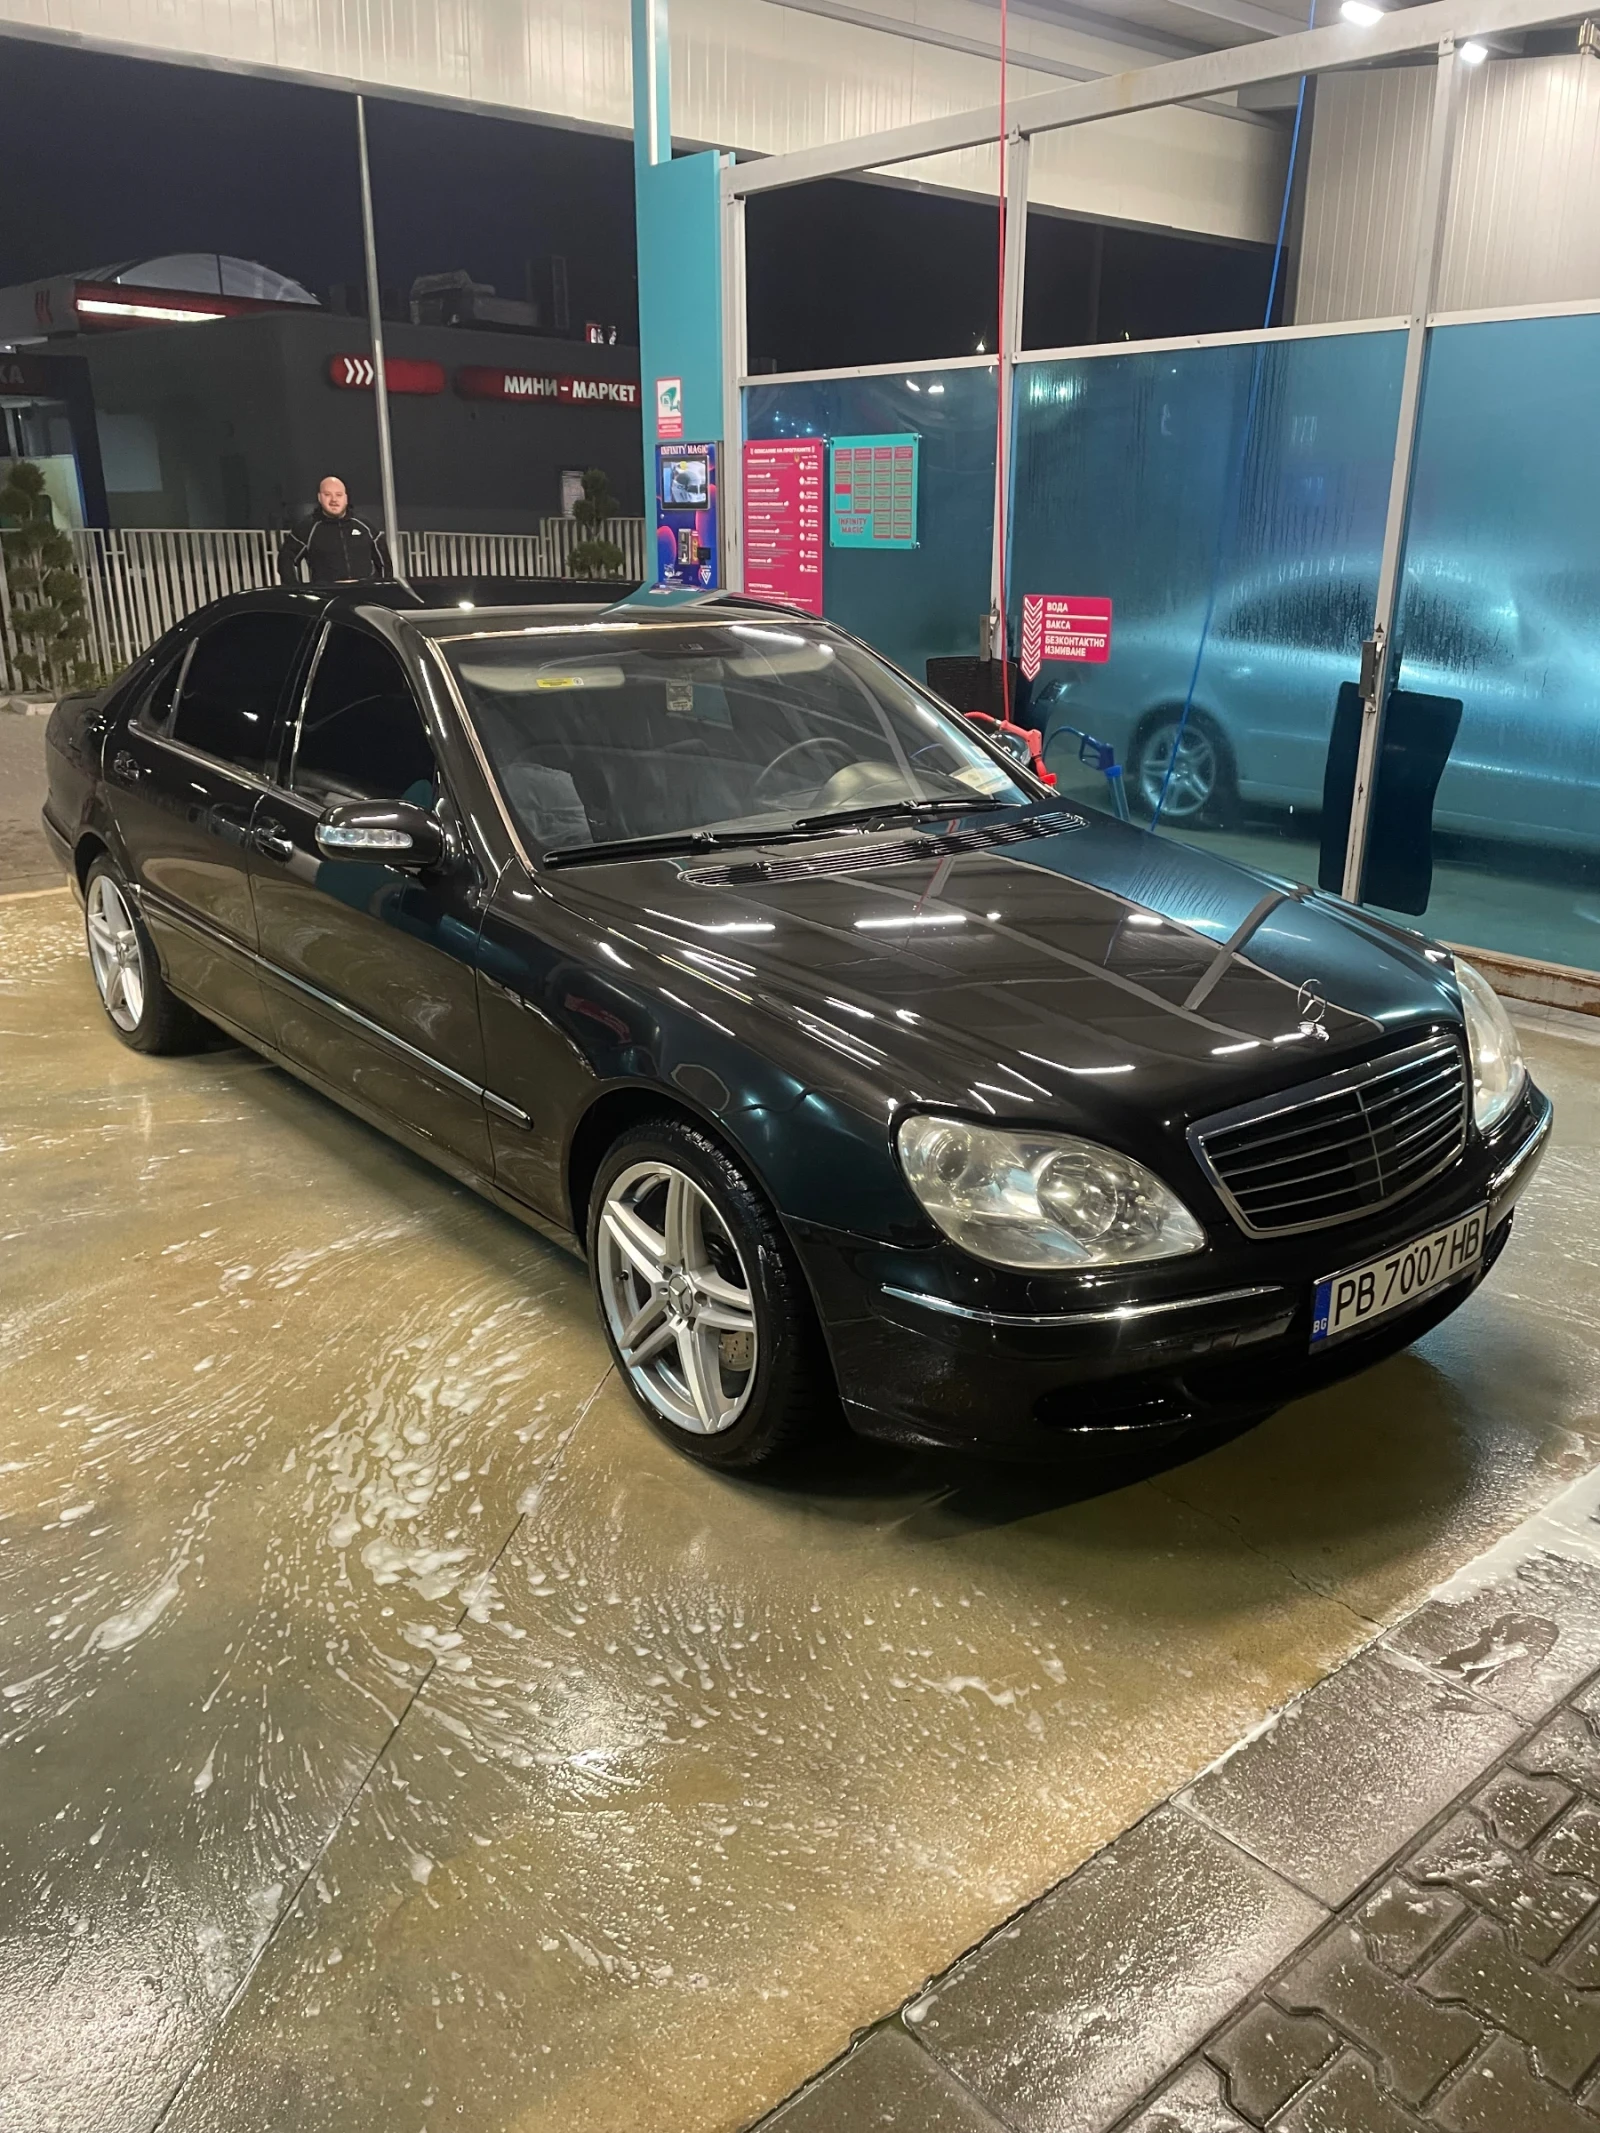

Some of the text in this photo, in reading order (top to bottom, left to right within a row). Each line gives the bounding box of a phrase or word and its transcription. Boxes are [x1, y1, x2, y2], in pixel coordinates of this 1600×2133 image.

[504, 375, 558, 396] МИНИ
[572, 380, 636, 402] МАРКЕТ
[660, 444, 709, 455] INFINITY MAGIC
[839, 517, 867, 525] INFINITY
[841, 526, 864, 534] MAGIC
[1046, 602, 1068, 612] ВОДА
[1045, 620, 1071, 630] ВАКСА
[1045, 635, 1105, 648] БЕЗКОНТАКТНО
[1044, 645, 1086, 657] ИЗМИВАНЕ
[1312, 1318, 1327, 1334] BG
